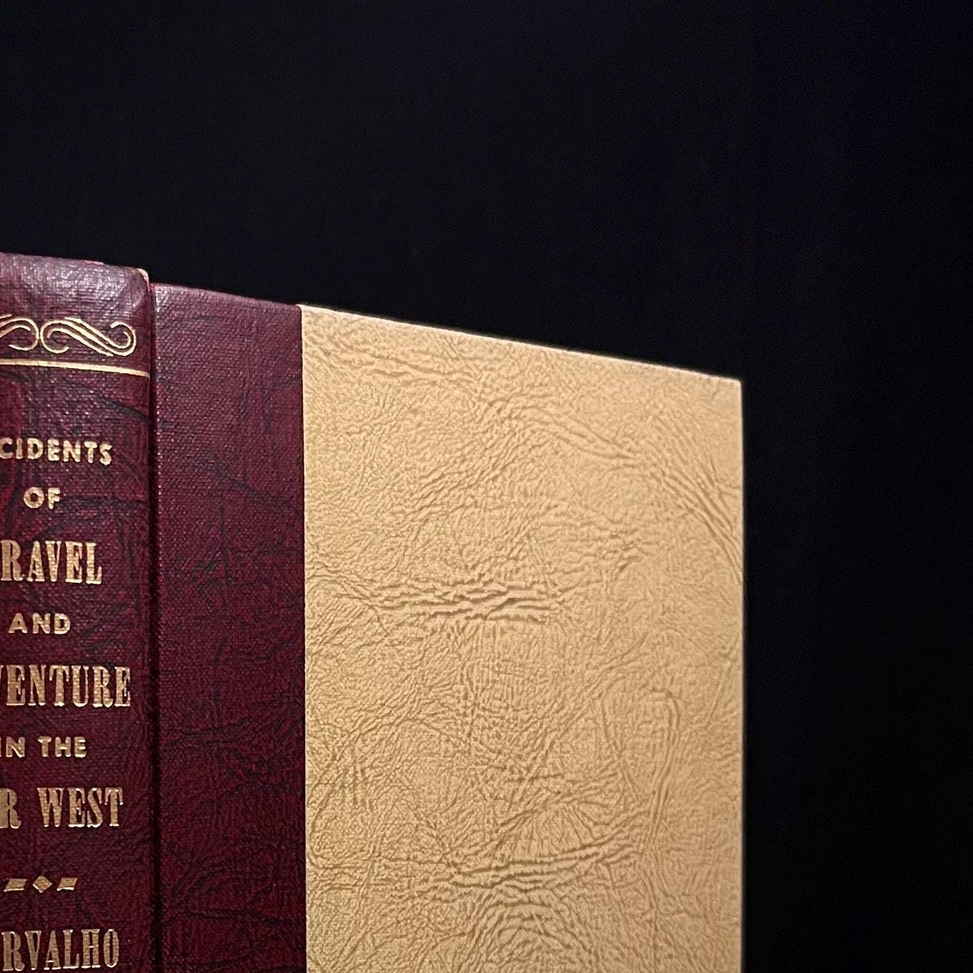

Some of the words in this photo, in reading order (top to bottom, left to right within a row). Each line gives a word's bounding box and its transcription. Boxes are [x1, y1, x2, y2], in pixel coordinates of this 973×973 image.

[22, 486, 62, 510] OF
[8, 612, 71, 635] AND
[38, 735, 87, 758] THE
[36, 786, 123, 828] WEST
